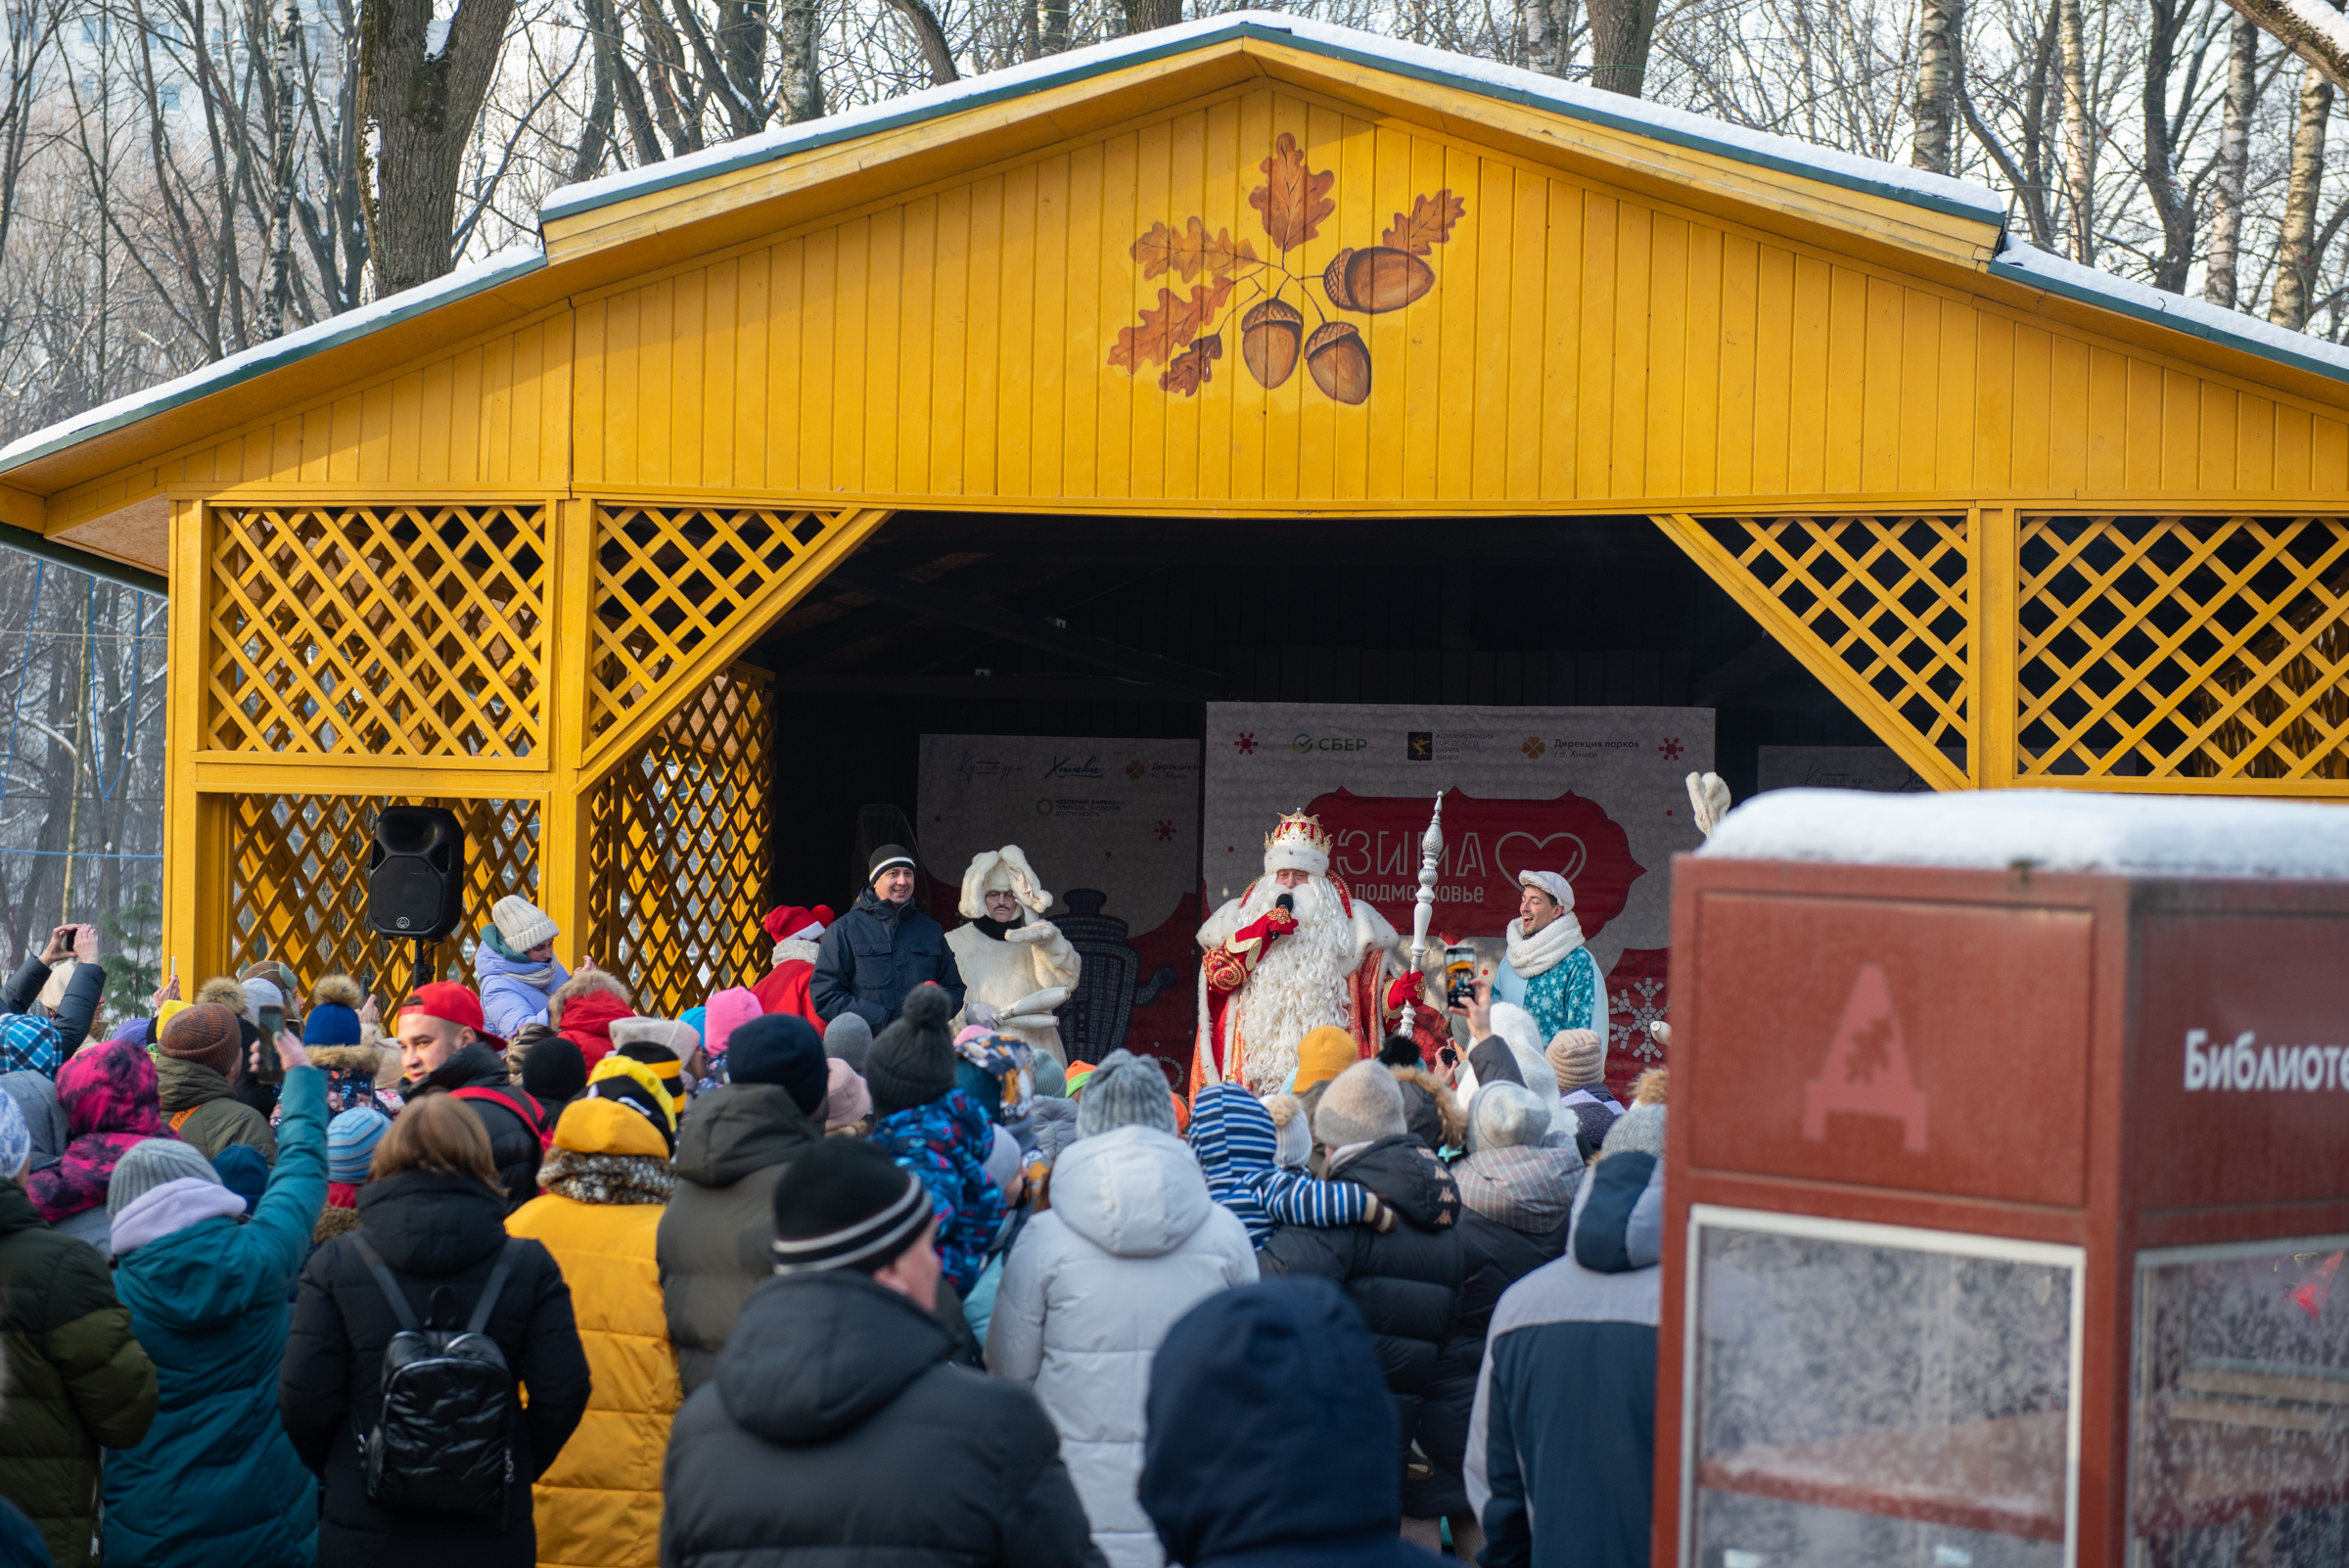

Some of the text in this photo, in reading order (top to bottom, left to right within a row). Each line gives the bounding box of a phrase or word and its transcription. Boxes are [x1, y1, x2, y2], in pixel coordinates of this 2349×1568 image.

[1318, 738, 1367, 752] СБЕР
[1554, 739, 1640, 750] Дирекция парков
[1570, 750, 1598, 759] Химки
[1043, 756, 1103, 779] Химки
[1151, 762, 1192, 771] Дирекция
[1355, 883, 1485, 903] подмоковье
